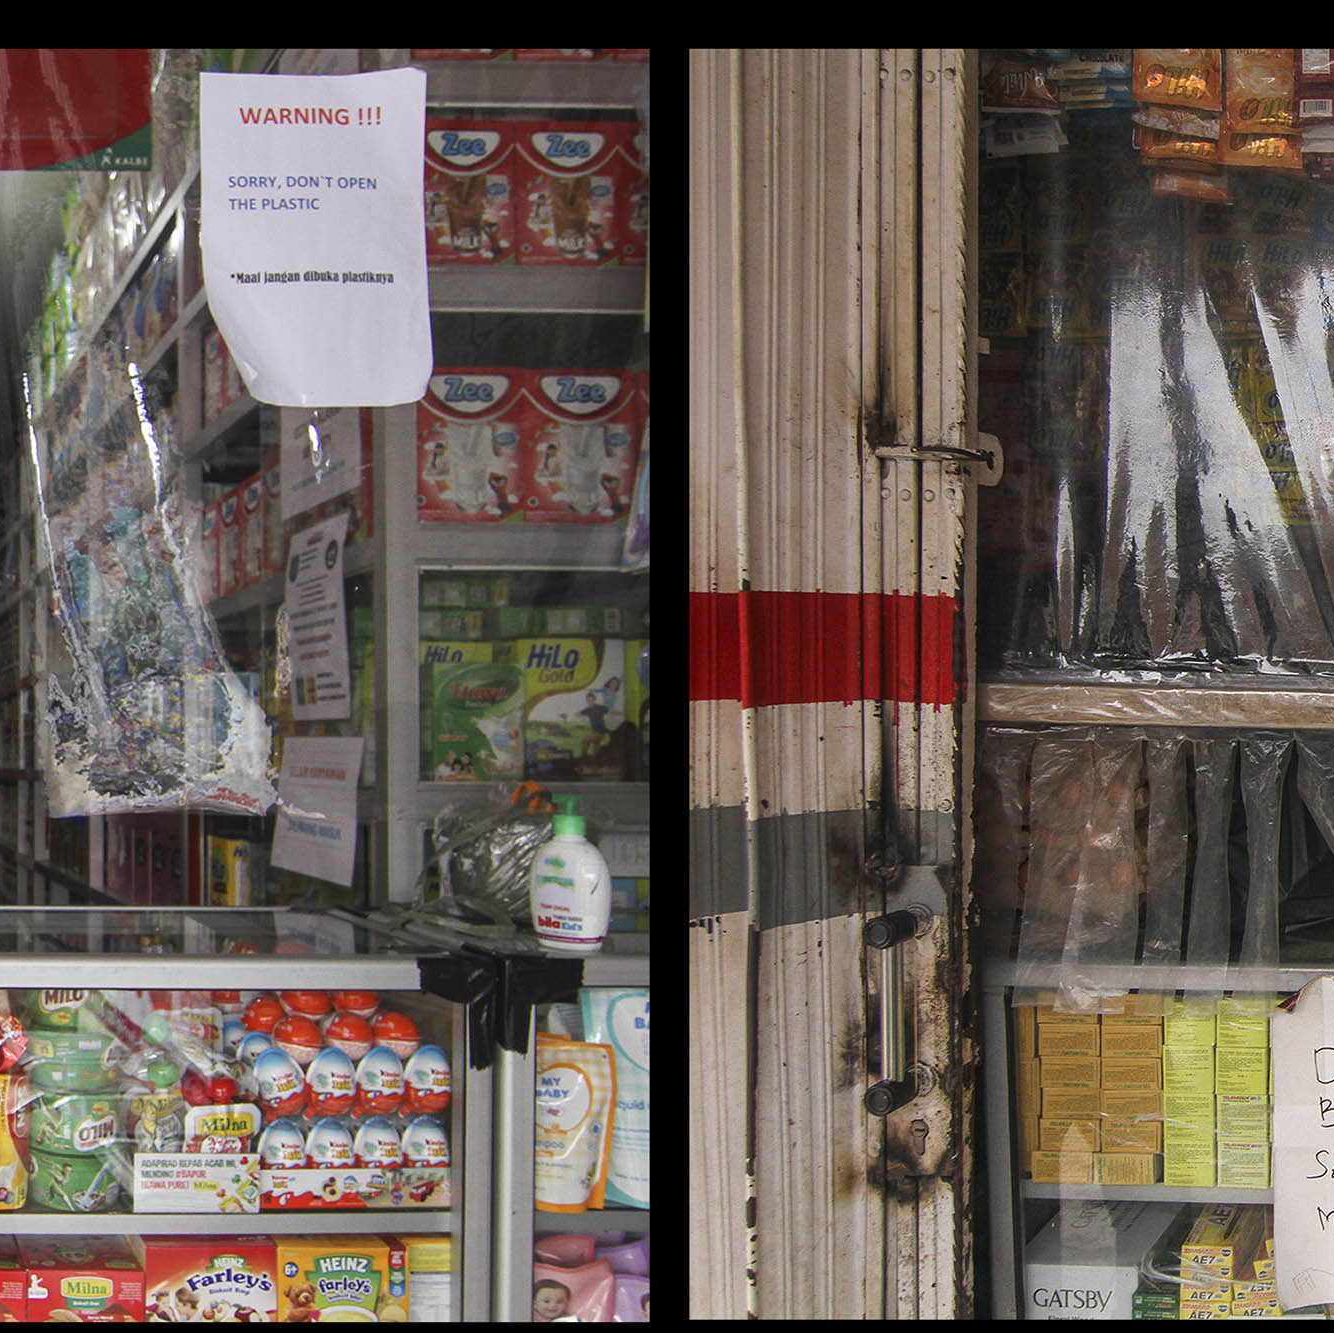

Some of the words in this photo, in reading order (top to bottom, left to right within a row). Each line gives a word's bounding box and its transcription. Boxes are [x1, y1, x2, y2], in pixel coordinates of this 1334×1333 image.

[240, 107, 350, 125] WARNING
[358, 107, 382, 125] !!!
[442, 133, 486, 156] Zee
[547, 134, 590, 157] Zee
[228, 176, 282, 189] SORRY,
[337, 177, 377, 190] OPEN
[229, 198, 257, 210] THE
[262, 198, 320, 210] PLASTIC
[264, 271, 300, 283] jangan
[304, 271, 339, 282] dibuka
[343, 271, 394, 284] plastiknya
[528, 643, 579, 670] HiLo
[214, 1256, 245, 1268] HEINZ
[319, 1258, 366, 1273] HEINZ
[186, 1269, 272, 1292] Farley's
[1033, 1288, 1113, 1310] GATSBY
